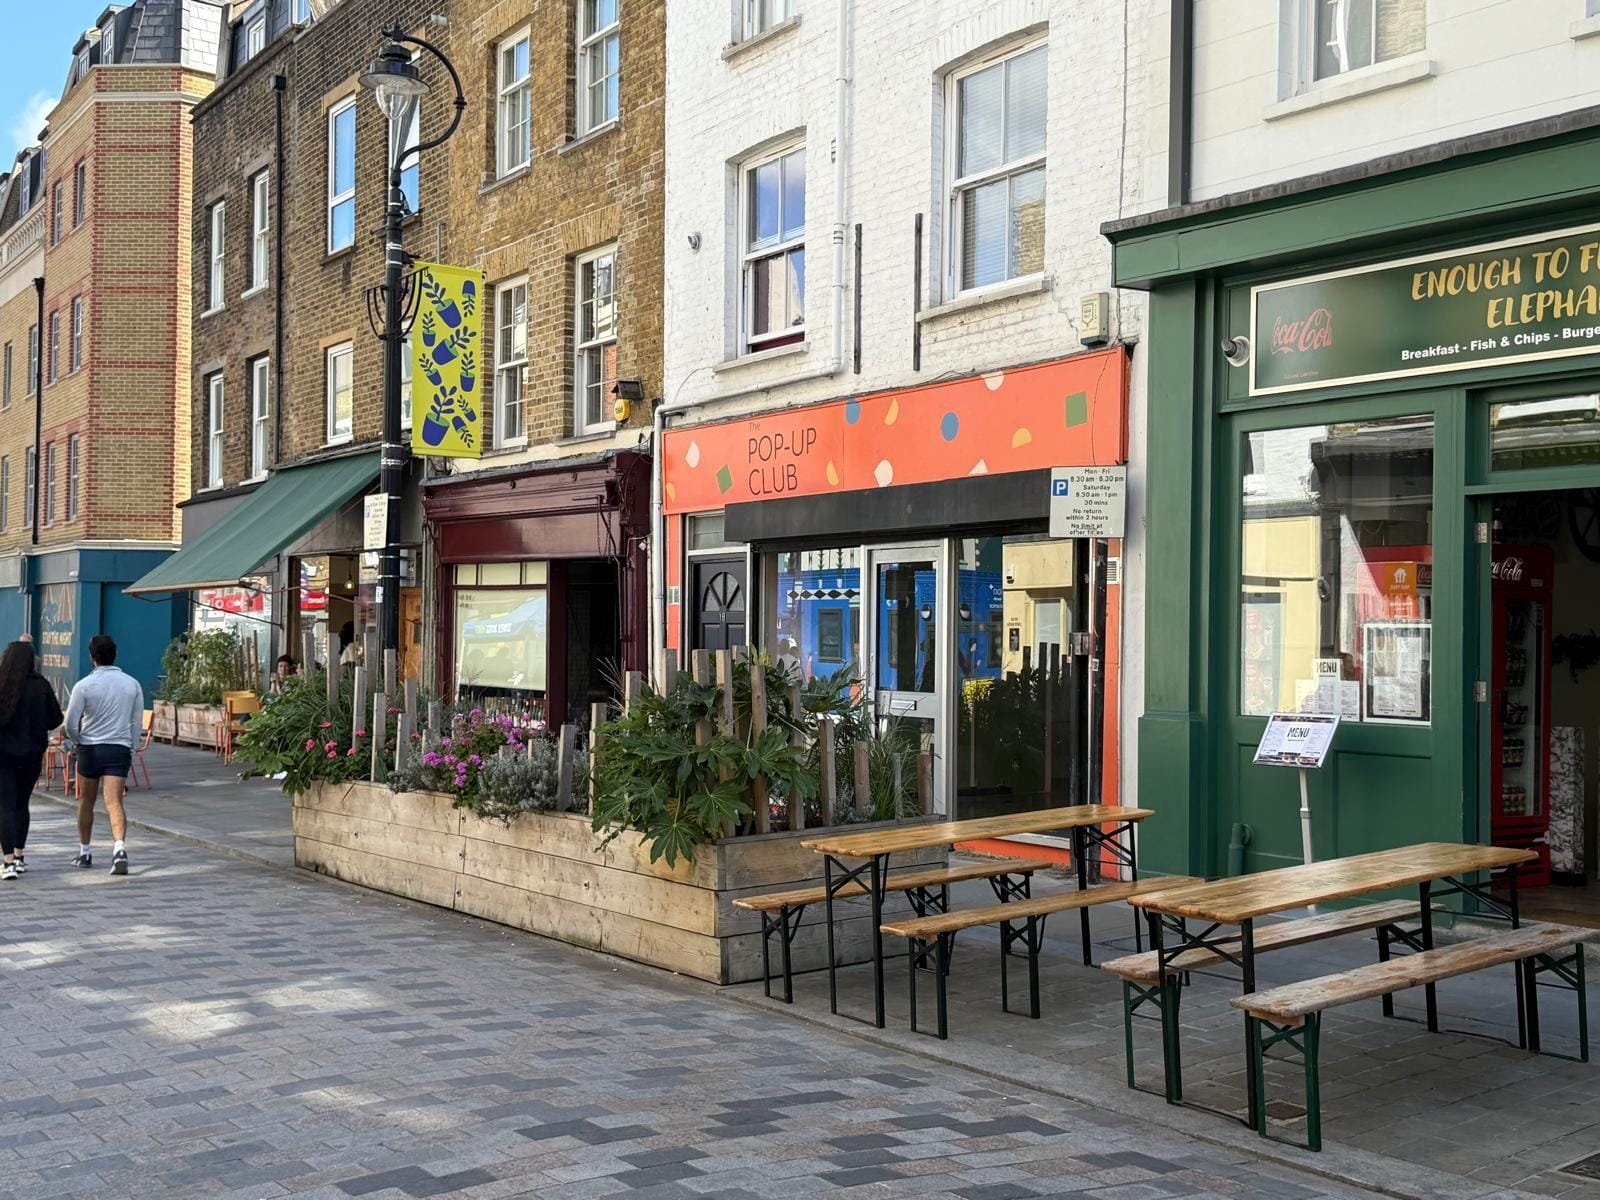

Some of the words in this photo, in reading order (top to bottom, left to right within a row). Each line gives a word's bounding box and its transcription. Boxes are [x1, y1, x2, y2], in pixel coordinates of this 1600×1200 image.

[1411, 257, 1521, 300] ENOUGH
[1532, 247, 1570, 284] TO
[1579, 242, 1600, 274] F
[1486, 284, 1600, 329] ELEPHA
[1401, 343, 1460, 361] Breakfast
[1470, 338, 1497, 352] Fish
[1500, 336, 1510, 347] &
[1514, 331, 1551, 346] Chips
[748, 422, 761, 432] The
[748, 427, 817, 464] POP-UP
[748, 464, 798, 495] CLUB
[1316, 662, 1337, 673] MENU
[1286, 727, 1311, 738] MENU
